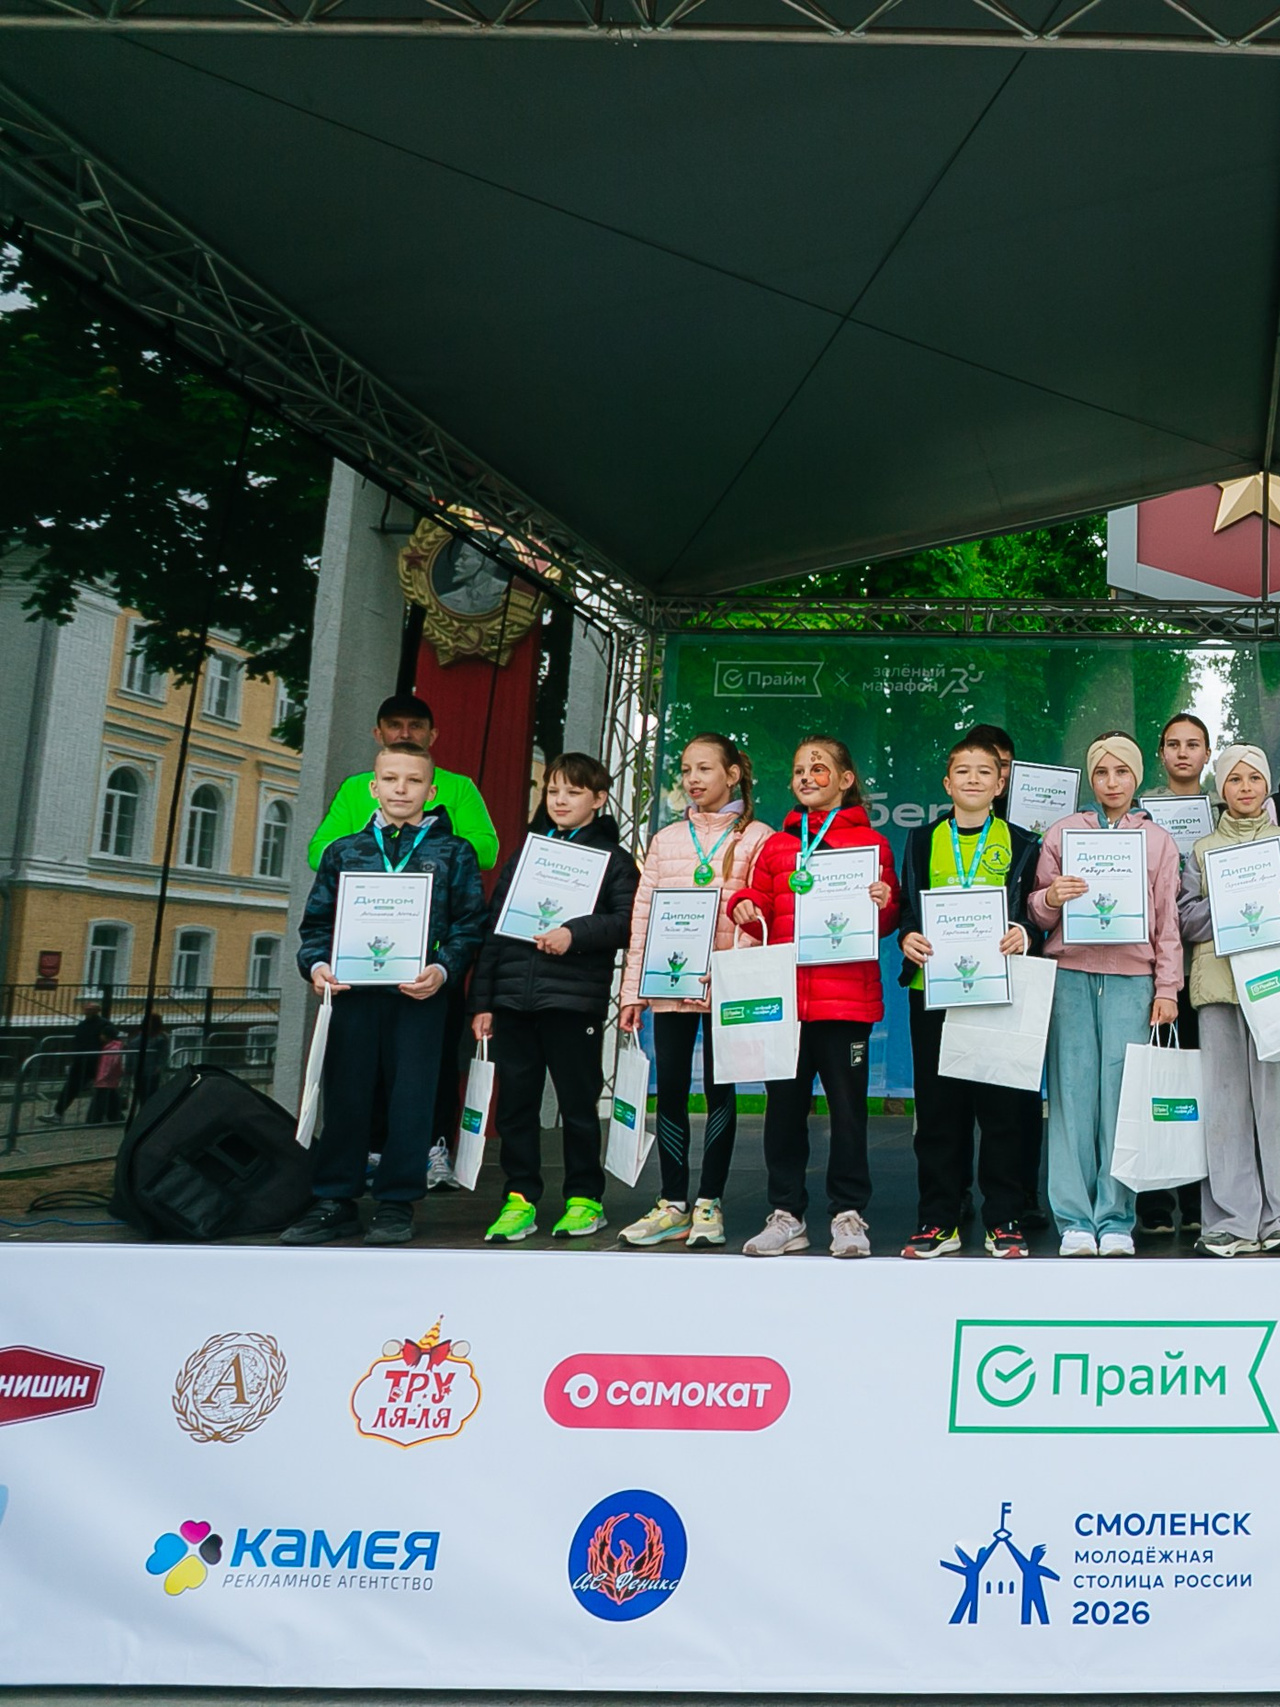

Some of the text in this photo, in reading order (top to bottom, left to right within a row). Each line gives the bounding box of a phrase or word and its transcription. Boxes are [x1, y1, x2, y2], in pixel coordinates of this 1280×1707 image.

[747, 671, 807, 689] Прайм
[1020, 783, 1067, 795] Диплом
[1156, 818, 1201, 826] Диплом
[1077, 852, 1131, 862] Диплом
[534, 857, 590, 876] Диплом
[1220, 861, 1272, 879] Диплом
[812, 872, 864, 882] Диплом
[354, 896, 414, 905] Диплом
[660, 912, 705, 920] Диплом
[936, 914, 992, 924] Диплом
[384, 1370, 456, 1404] ТРУ
[1052, 1351, 1227, 1407] Прайм
[606, 1380, 772, 1408] самокат
[371, 1407, 452, 1429] ЛЯ-ЛЯ
[1074, 1512, 1252, 1537] СМОЛЕНСК
[1074, 1546, 1214, 1566] МОЛОДЁЖНАЯ
[223, 1574, 433, 1591] РЕКЛАМНОЕ АГЕНТСТВО
[616, 1569, 680, 1592] Феникс
[1073, 1573, 1252, 1591] СТОЛИЦА РОССИИ
[1072, 1600, 1151, 1626] 2026
